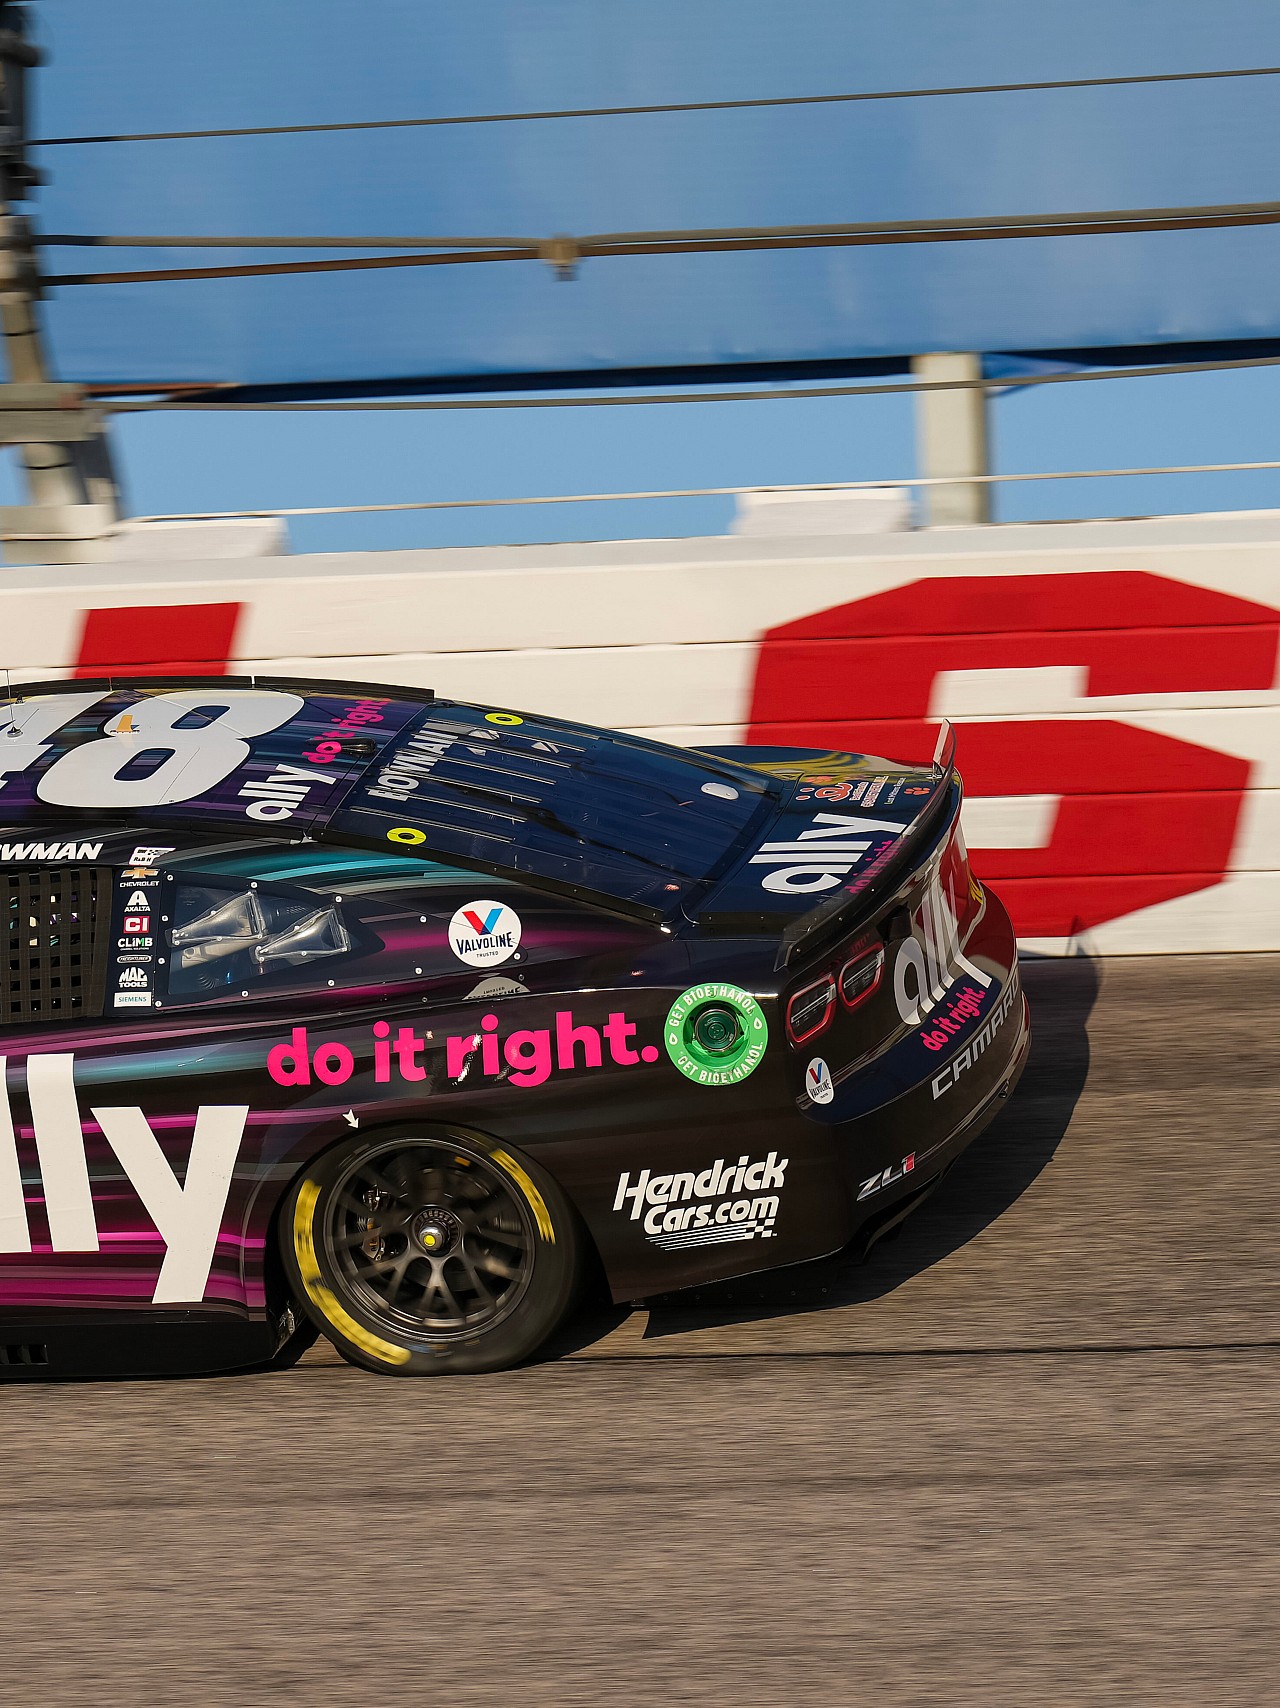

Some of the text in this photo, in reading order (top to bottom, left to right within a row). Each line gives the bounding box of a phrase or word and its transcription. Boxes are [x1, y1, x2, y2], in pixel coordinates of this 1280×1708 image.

[302, 741, 342, 763] do
[238, 764, 337, 821] ally
[748, 813, 916, 894] ally
[120, 880, 160, 888] CHEVROLET
[456, 931, 514, 956] VALVOLINE
[476, 950, 499, 958] TRUSTED
[118, 966, 148, 983] MAC
[669, 1004, 686, 1027] GET
[932, 1016, 961, 1035] it
[267, 1011, 660, 1088] do it right.
[920, 1031, 949, 1051] do
[677, 1044, 763, 1084] GET BIOETHANOL
[613, 1151, 789, 1221] Hendrick
[643, 1195, 780, 1235] Cars.com
